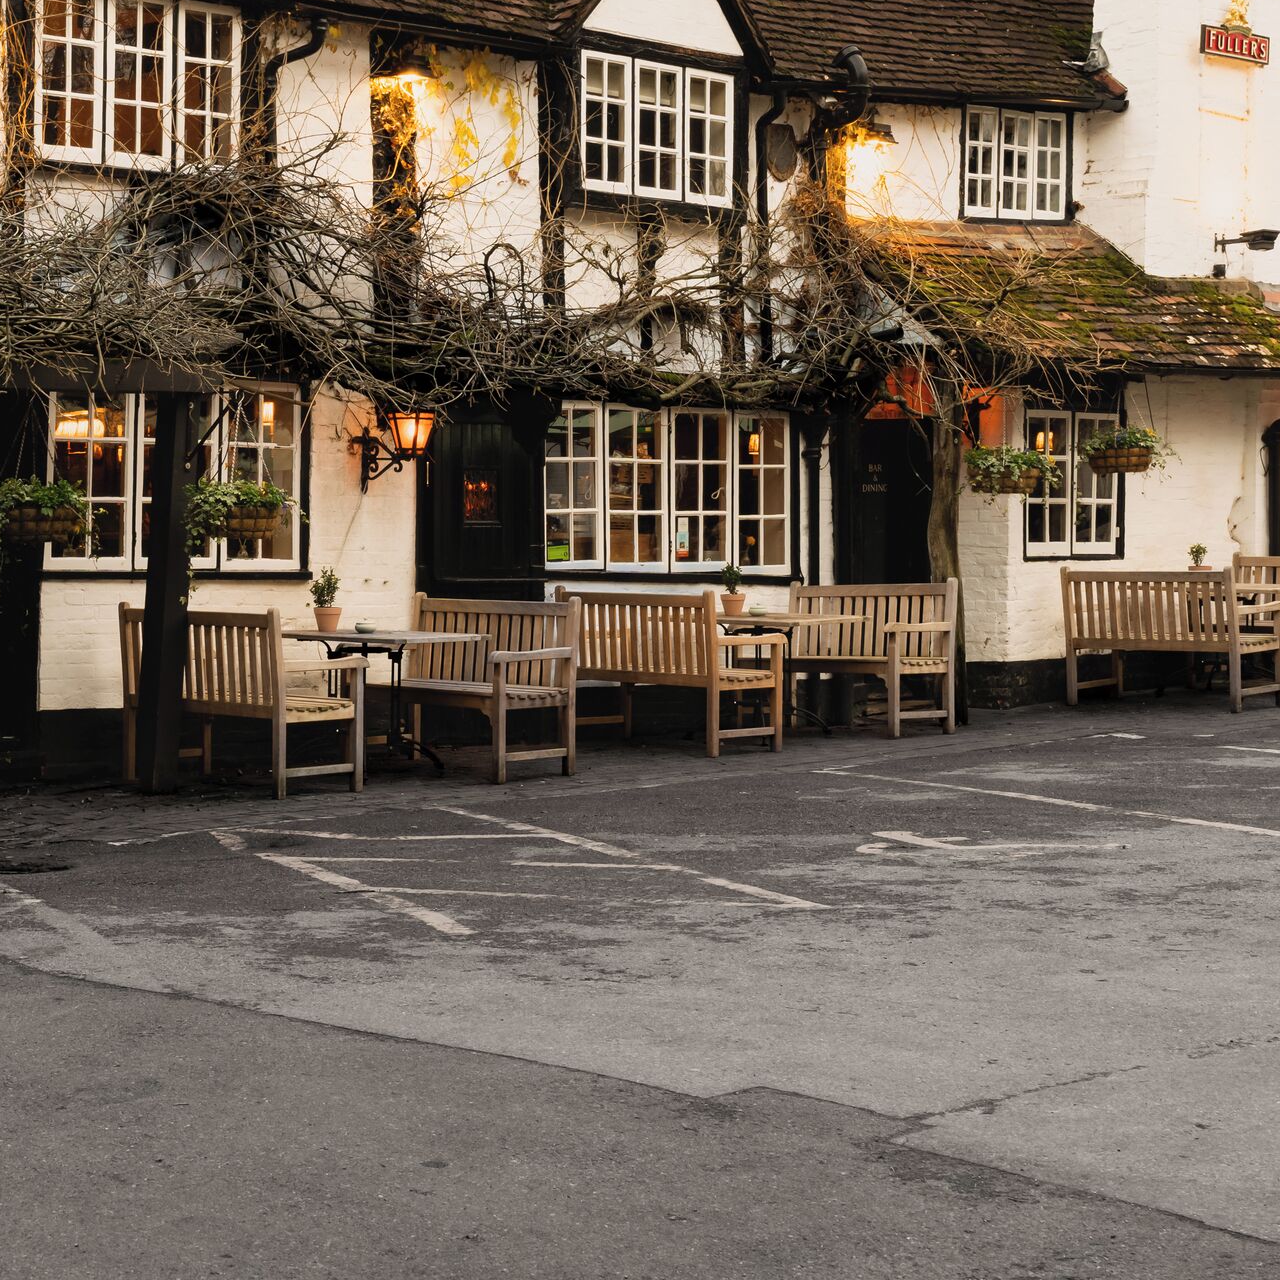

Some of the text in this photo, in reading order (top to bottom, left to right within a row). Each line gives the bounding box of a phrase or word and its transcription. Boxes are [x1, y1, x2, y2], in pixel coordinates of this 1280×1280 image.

[1208, 30, 1267, 59] FULLER'S
[868, 463, 882, 473] BAR
[862, 483, 888, 493] DINING
